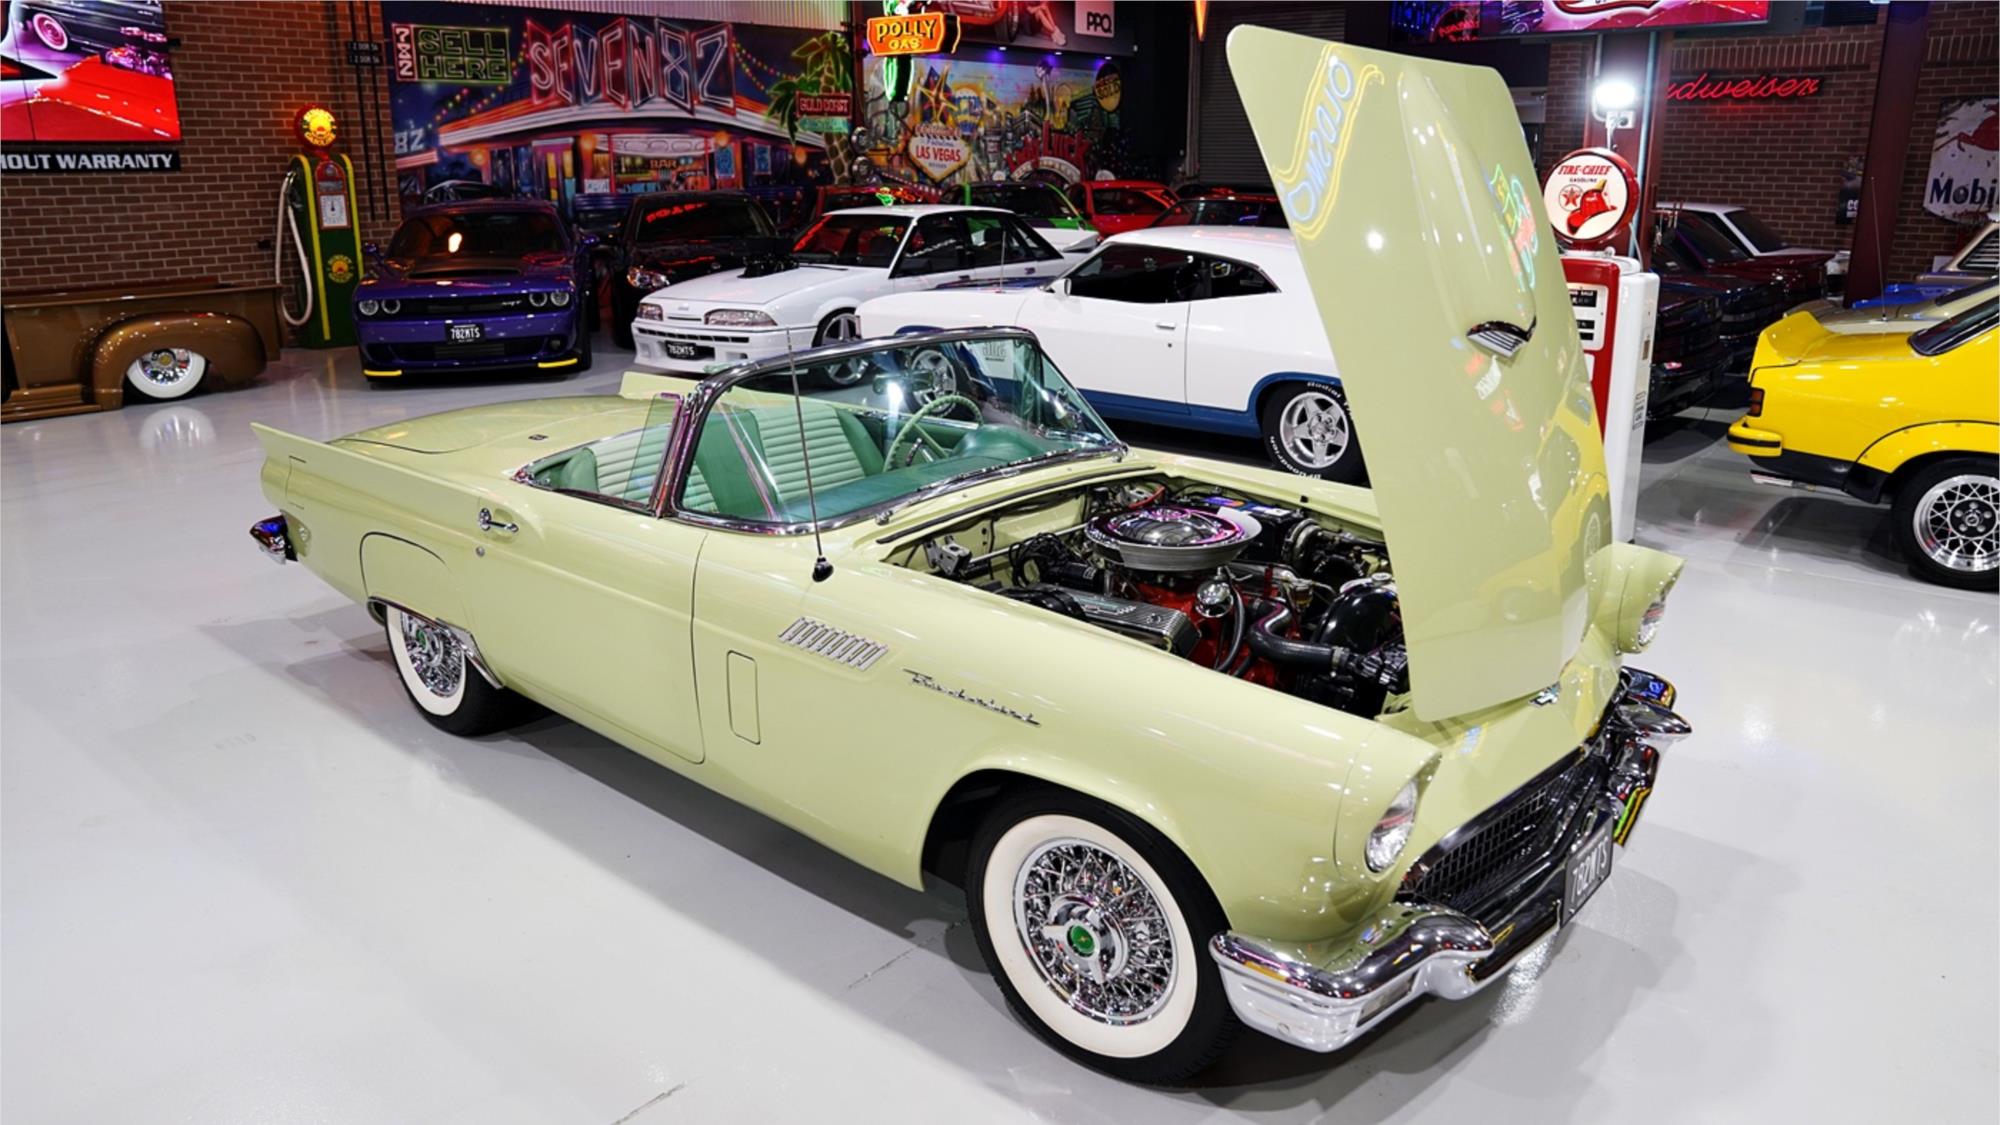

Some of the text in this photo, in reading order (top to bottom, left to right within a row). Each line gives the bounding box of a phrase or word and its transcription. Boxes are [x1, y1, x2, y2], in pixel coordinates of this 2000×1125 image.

[876, 19, 937, 42] POLLY
[1086, 11, 1112, 33] PPQ
[418, 29, 505, 56] SELL
[888, 39, 922, 50] GAS
[420, 55, 507, 80] HERE
[1665, 72, 1822, 100] udweiser
[56, 153, 172, 169] WARRANTY
[916, 146, 961, 162] LAS VEGAS
[650, 160, 677, 169] BAR
[1558, 165, 1612, 175] FIRE-CHIEF
[1929, 178, 2000, 208] Mobi
[451, 327, 480, 339] 782MTS
